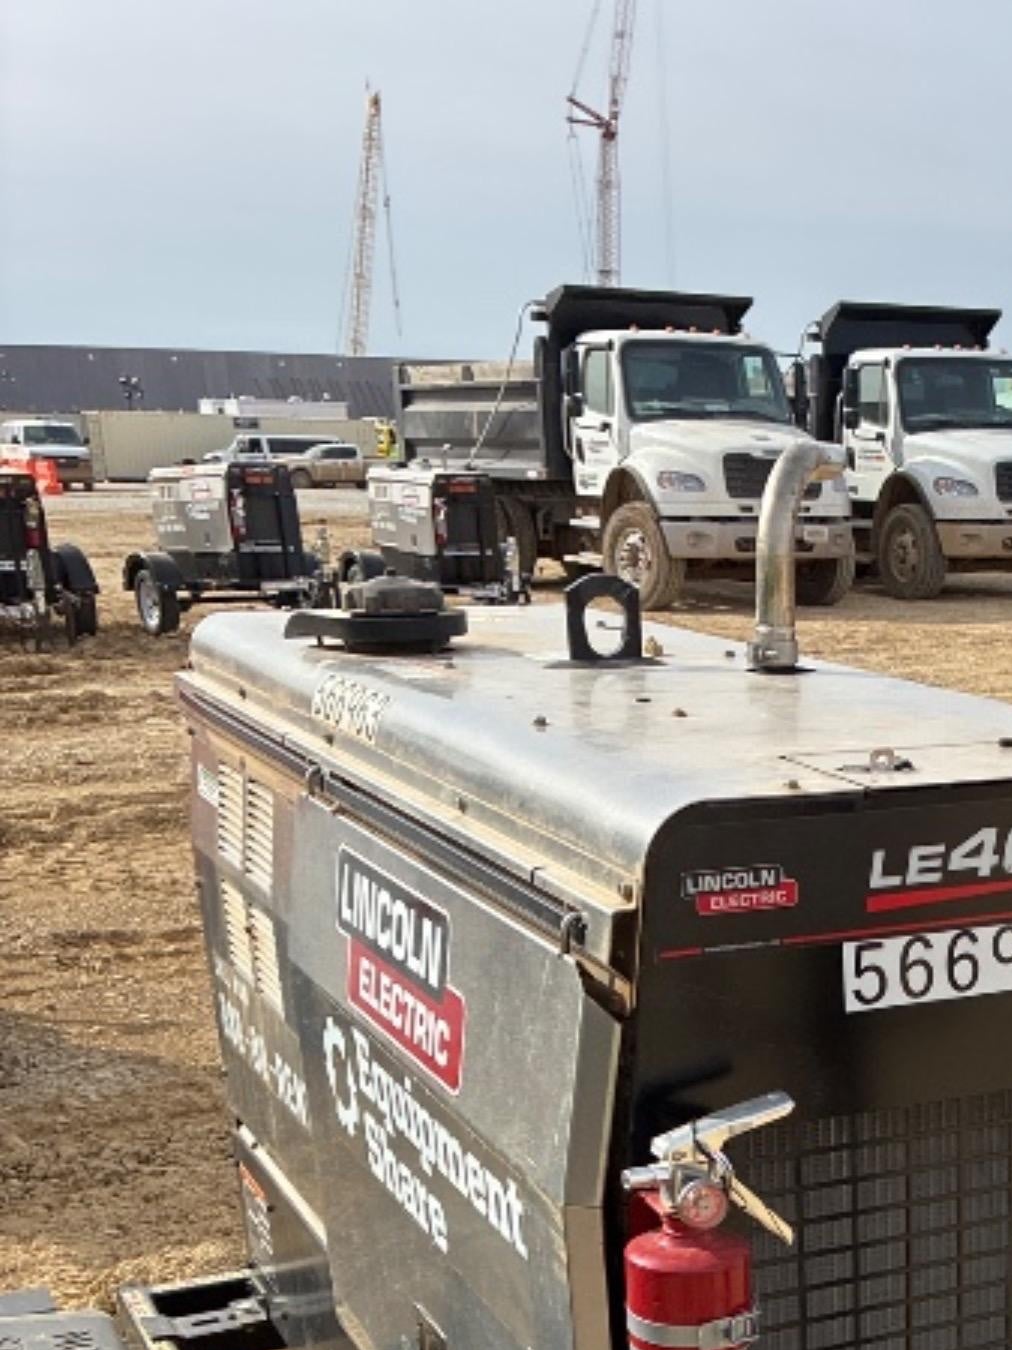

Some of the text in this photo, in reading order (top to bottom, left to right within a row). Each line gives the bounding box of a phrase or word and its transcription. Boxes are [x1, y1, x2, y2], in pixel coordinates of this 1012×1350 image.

[340, 862, 443, 989] LINCOLN
[685, 868, 777, 895] LINCOLN
[709, 889, 788, 911] ELECTRIC
[358, 955, 452, 1068] ELECTRIC
[351, 1025, 529, 1262] Equipment
[363, 1110, 450, 1255] Share
